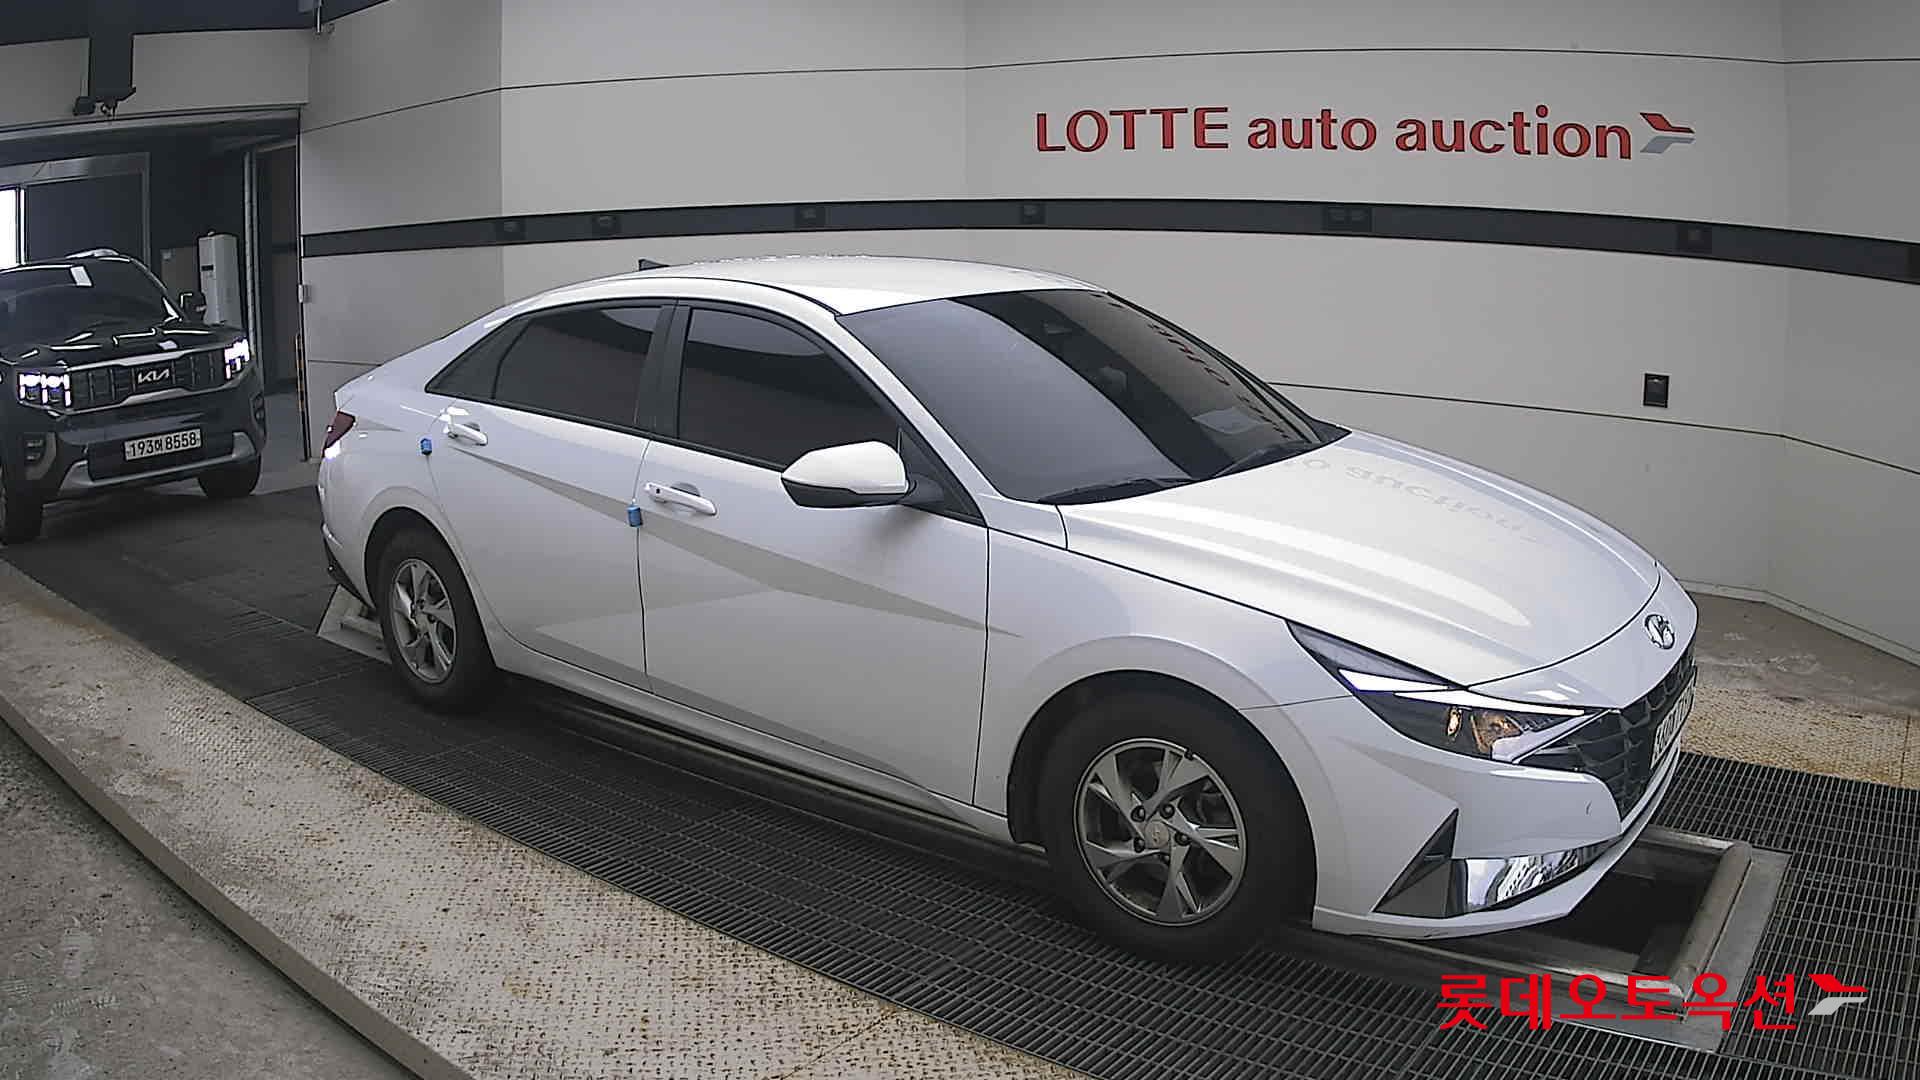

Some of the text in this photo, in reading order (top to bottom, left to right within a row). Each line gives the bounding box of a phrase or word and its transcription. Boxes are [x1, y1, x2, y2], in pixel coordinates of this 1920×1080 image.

[1036, 104, 1632, 159] LOTTE auto auction
[137, 368, 170, 384] KIA
